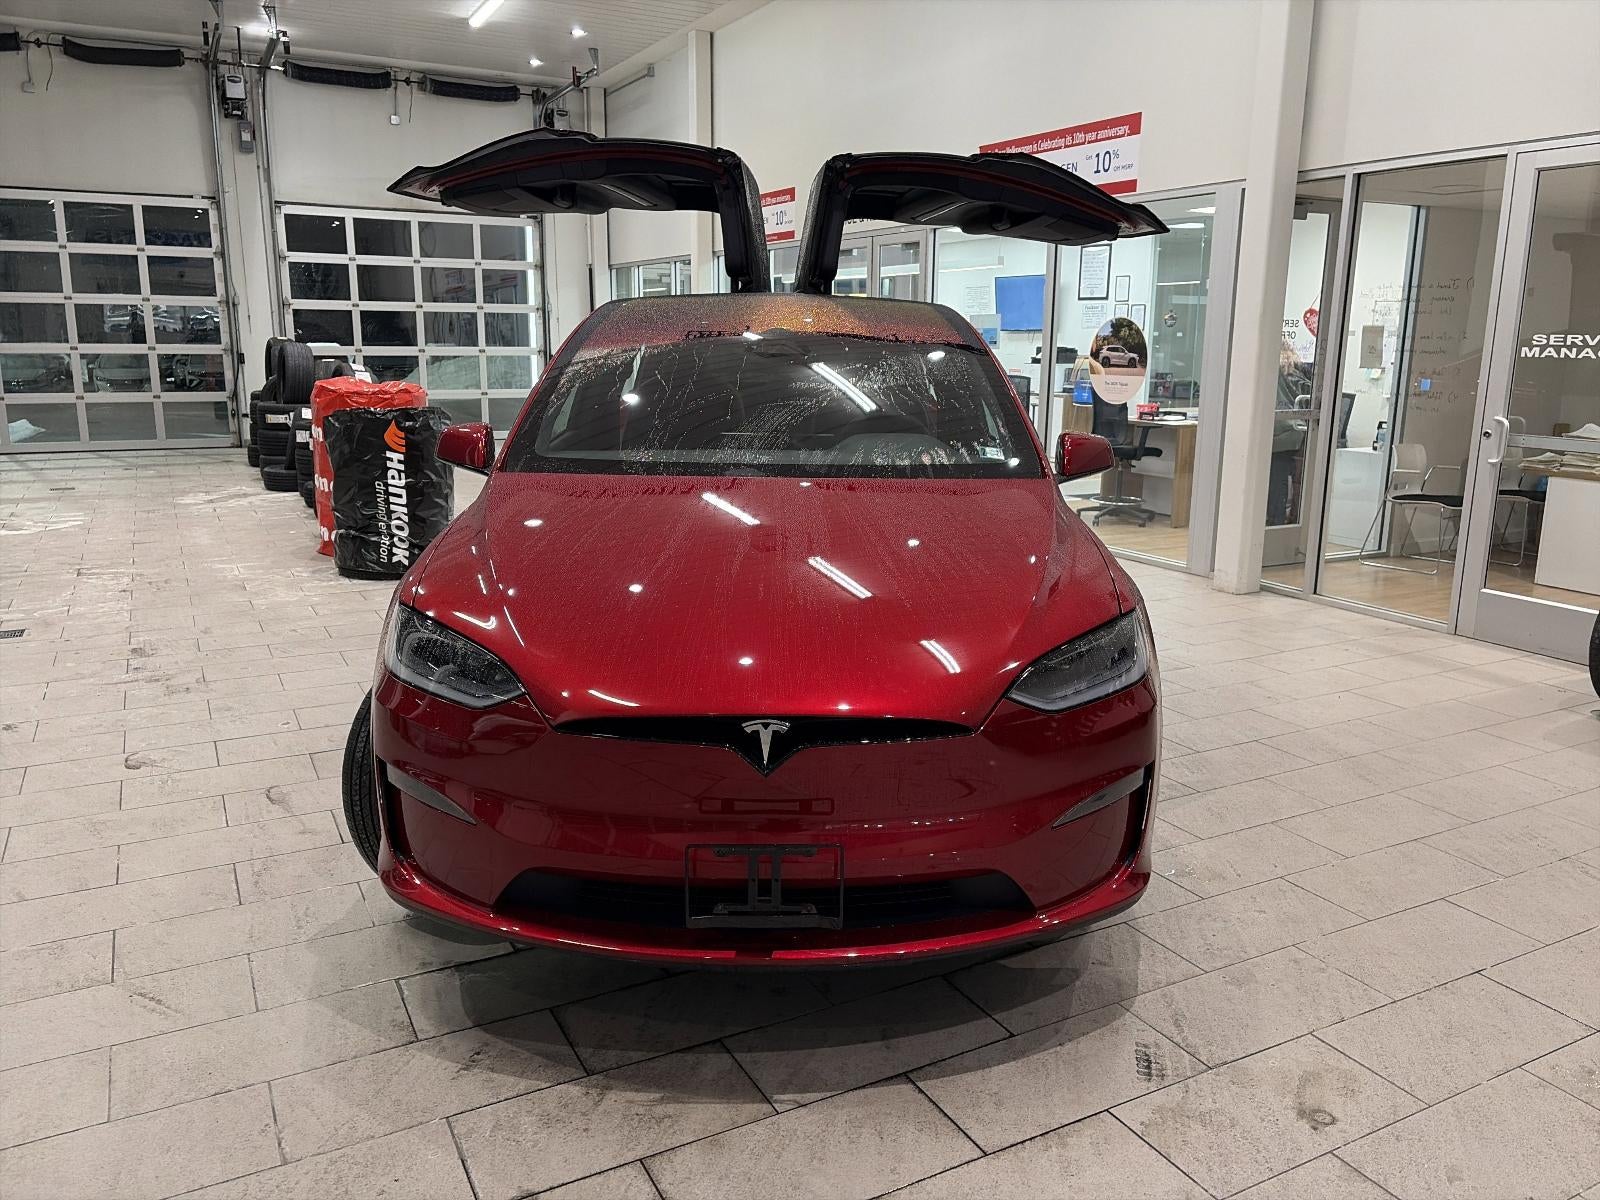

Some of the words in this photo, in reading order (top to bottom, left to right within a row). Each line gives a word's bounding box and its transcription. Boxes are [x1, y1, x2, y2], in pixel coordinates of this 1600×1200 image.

[1038, 136, 1065, 151] Celebrating
[1073, 131, 1085, 144] 10th
[1085, 131, 1097, 145] year
[1531, 334, 1600, 346] SERV
[1520, 346, 1600, 359] MANA
[375, 480, 388, 520] driving
